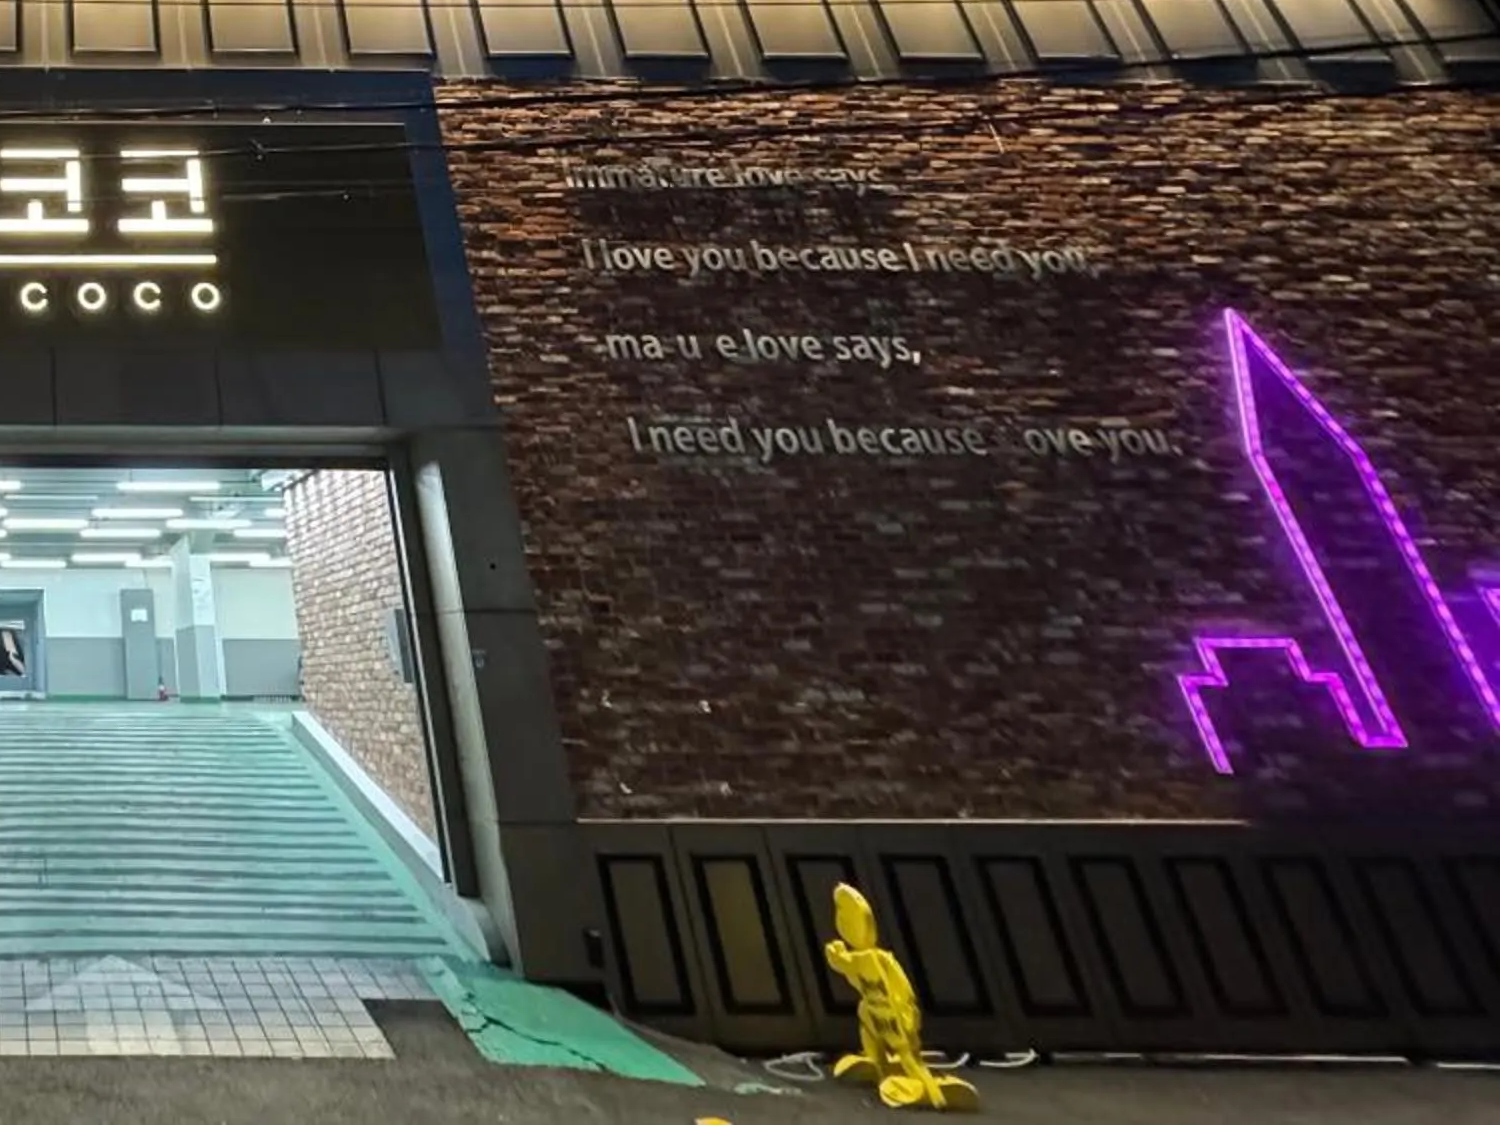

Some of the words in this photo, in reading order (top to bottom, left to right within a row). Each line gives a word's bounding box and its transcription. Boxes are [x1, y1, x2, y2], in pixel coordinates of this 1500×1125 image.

[599, 237, 674, 271] love
[682, 246, 748, 276] you
[750, 239, 899, 272] because
[924, 244, 1016, 273] need
[742, 327, 825, 361] love
[626, 415, 643, 454] I
[647, 415, 746, 455] need
[750, 426, 825, 464] you
[826, 417, 988, 456] because
